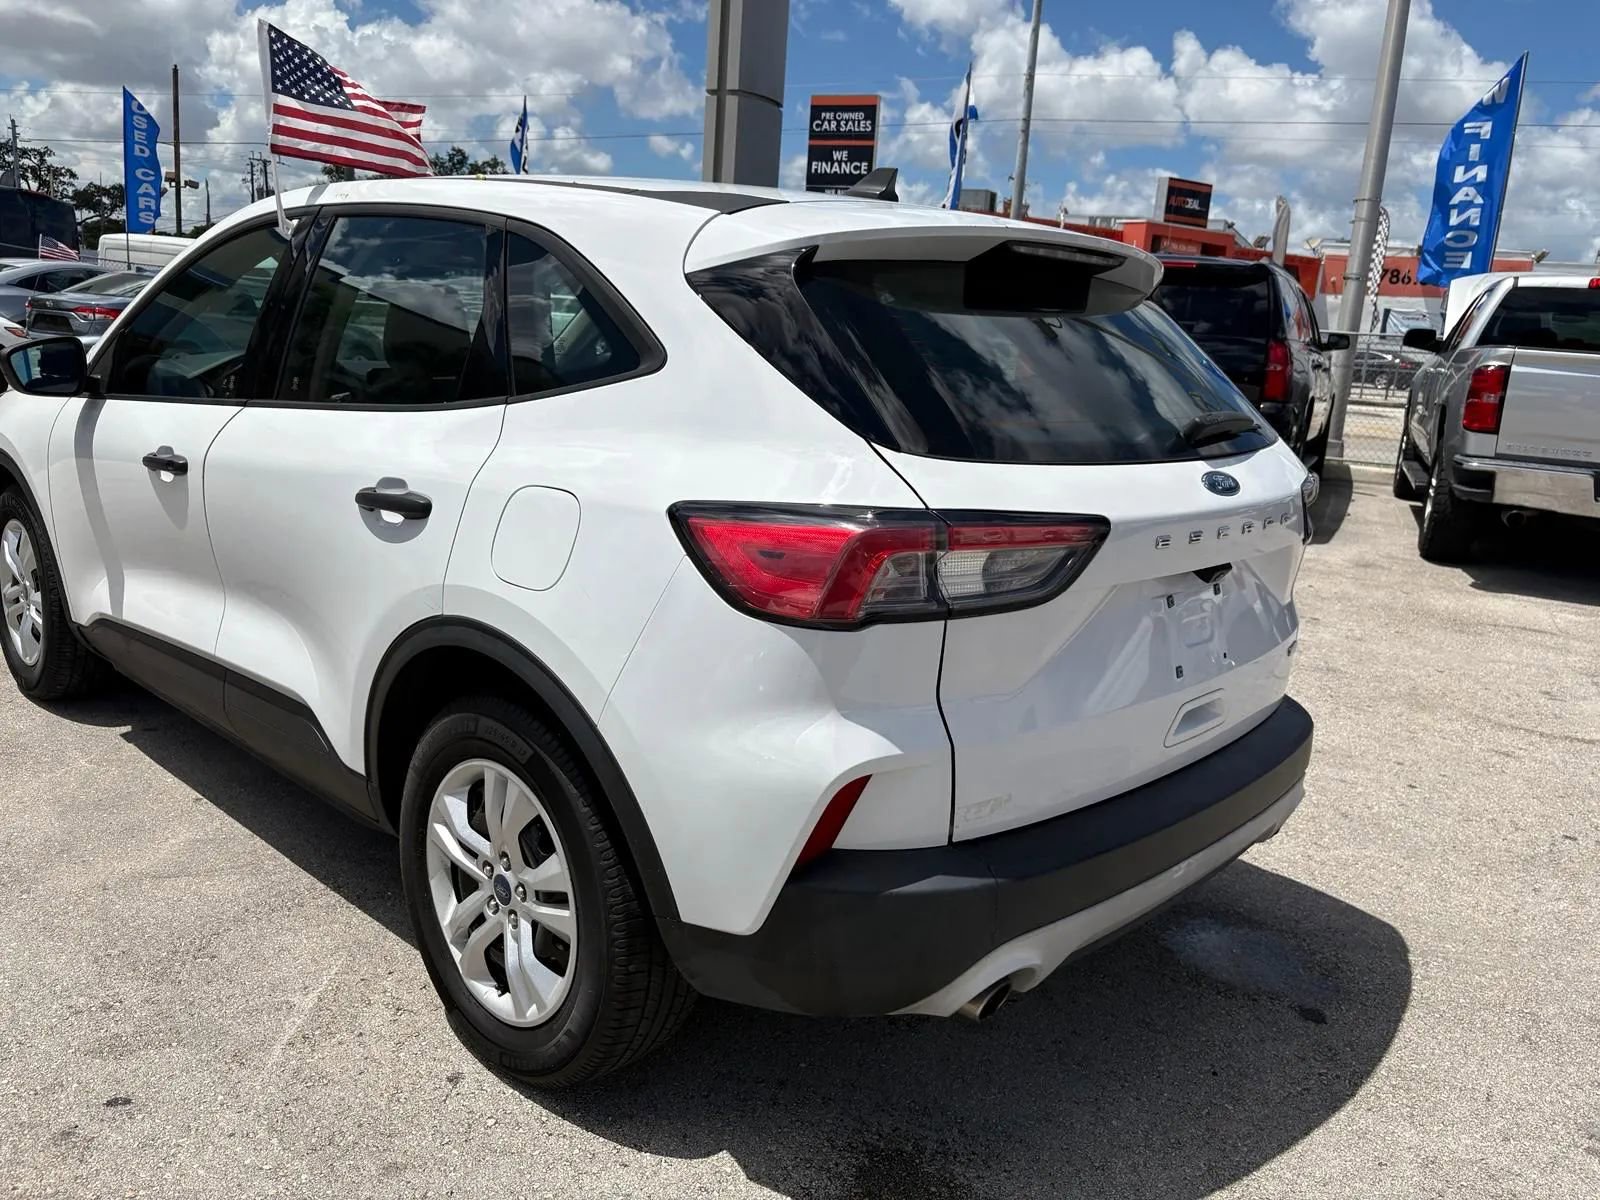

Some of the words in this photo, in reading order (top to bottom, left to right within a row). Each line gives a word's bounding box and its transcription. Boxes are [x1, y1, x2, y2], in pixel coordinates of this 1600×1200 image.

[821, 111, 835, 121] PRE
[836, 111, 865, 121] OWNED
[131, 99, 151, 158] USED
[812, 120, 838, 132] CAR
[840, 120, 872, 132] SALES
[832, 150, 849, 161] WE
[811, 161, 869, 175] FINANCE
[135, 168, 155, 224] CARS
